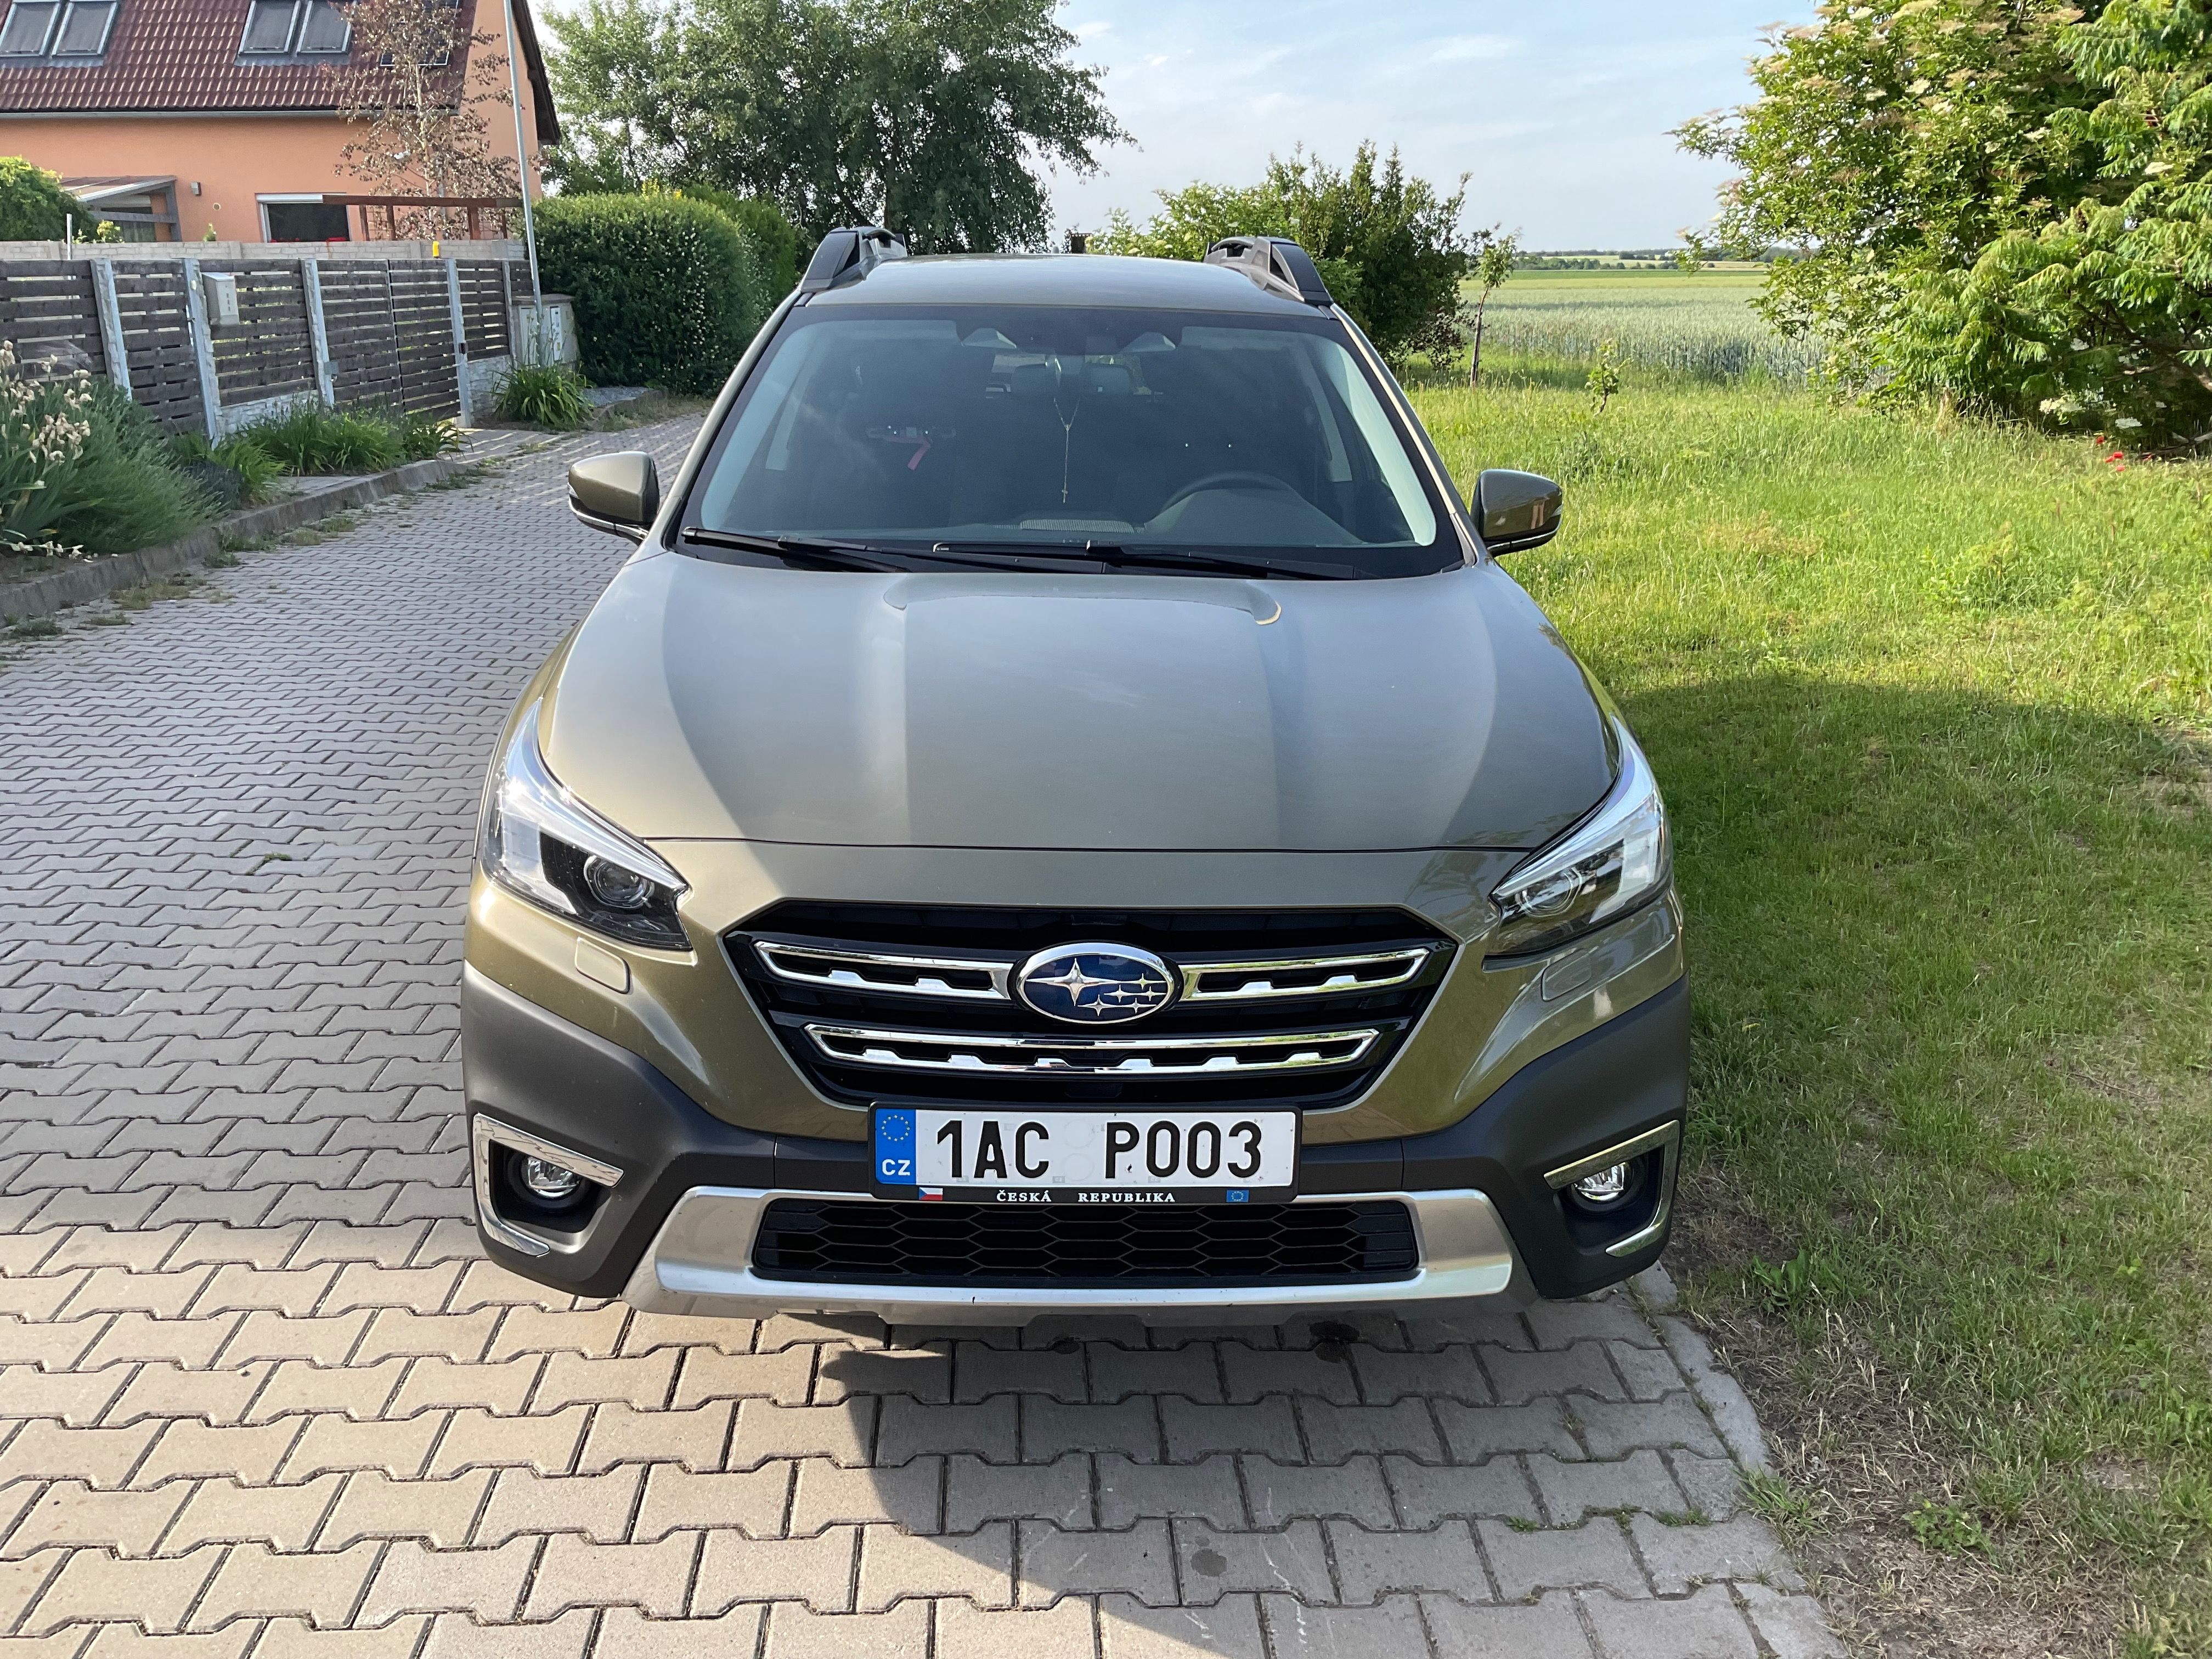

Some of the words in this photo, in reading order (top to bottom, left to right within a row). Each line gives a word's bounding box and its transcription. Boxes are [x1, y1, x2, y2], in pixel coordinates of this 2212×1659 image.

[937, 1120, 1049, 1179] 1AC
[1105, 1120, 1262, 1179] P003
[882, 1159, 911, 1176] CZ
[996, 1189, 1052, 1202] ČESKÁ
[1077, 1193, 1176, 1203] REPUBLIKA
